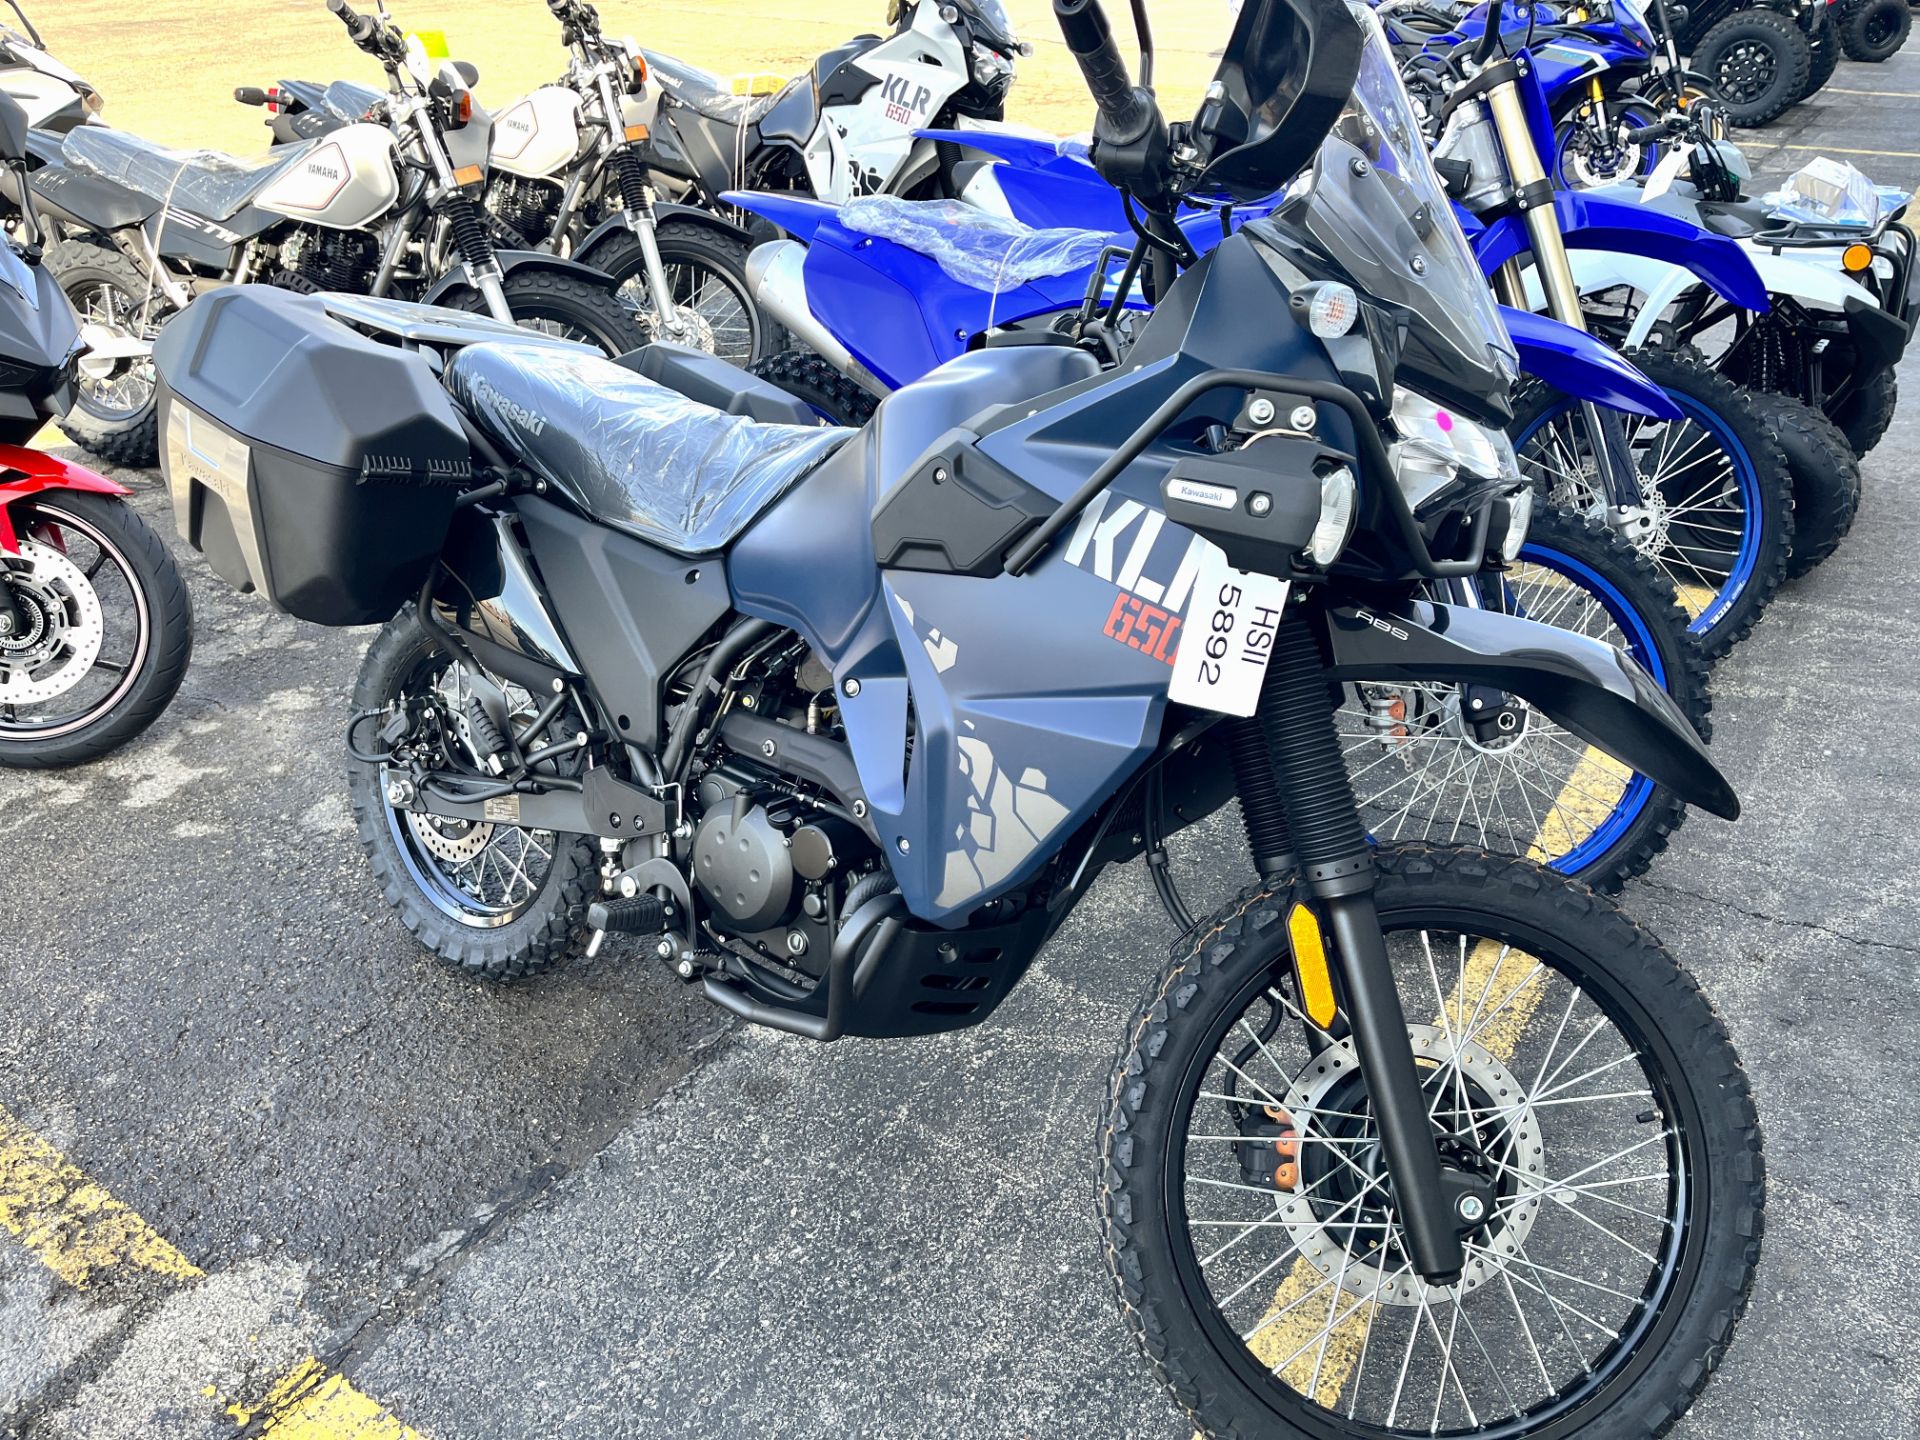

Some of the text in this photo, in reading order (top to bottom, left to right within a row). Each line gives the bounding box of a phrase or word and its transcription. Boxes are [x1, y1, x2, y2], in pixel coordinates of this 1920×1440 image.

[880, 73, 932, 115] KLR
[885, 103, 912, 125] 650
[307, 163, 338, 180] YAMAHA
[203, 221, 242, 243] TW
[467, 371, 547, 436] Kawasaki
[1181, 486, 1222, 502] Kawasaki
[1197, 583, 1242, 686] 5892
[1241, 606, 1279, 666] HSII
[1355, 610, 1409, 641] ABS
